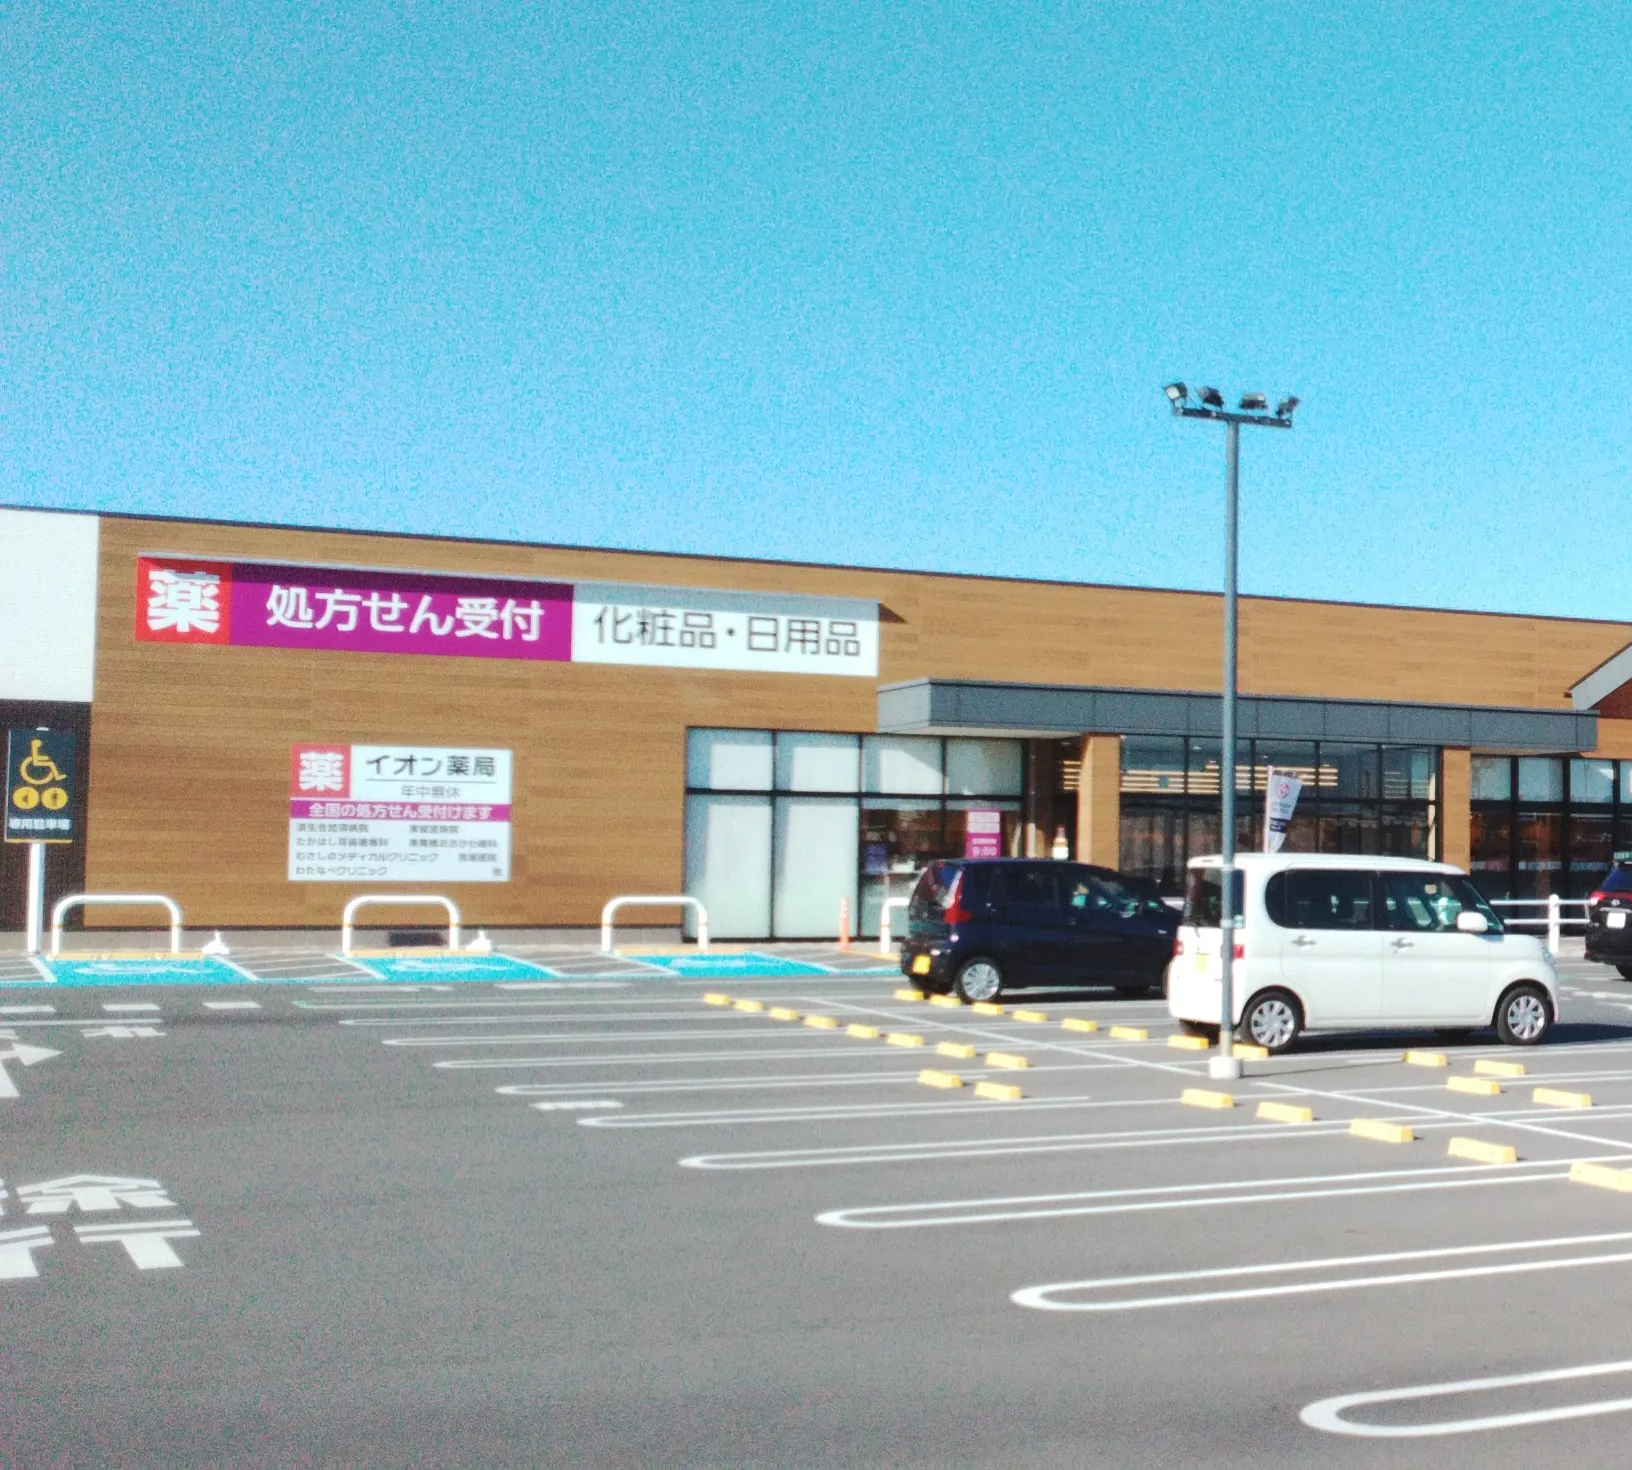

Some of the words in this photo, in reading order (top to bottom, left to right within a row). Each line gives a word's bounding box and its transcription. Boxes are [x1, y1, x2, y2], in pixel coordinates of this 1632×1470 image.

[148, 566, 220, 635] 薬
[265, 583, 546, 643] 処方せん受付
[593, 606, 862, 657] 化粧品・日用品
[298, 751, 345, 792] 薬
[366, 754, 496, 777] イオン薬局
[308, 802, 494, 820] 全国の処方せん受付けます
